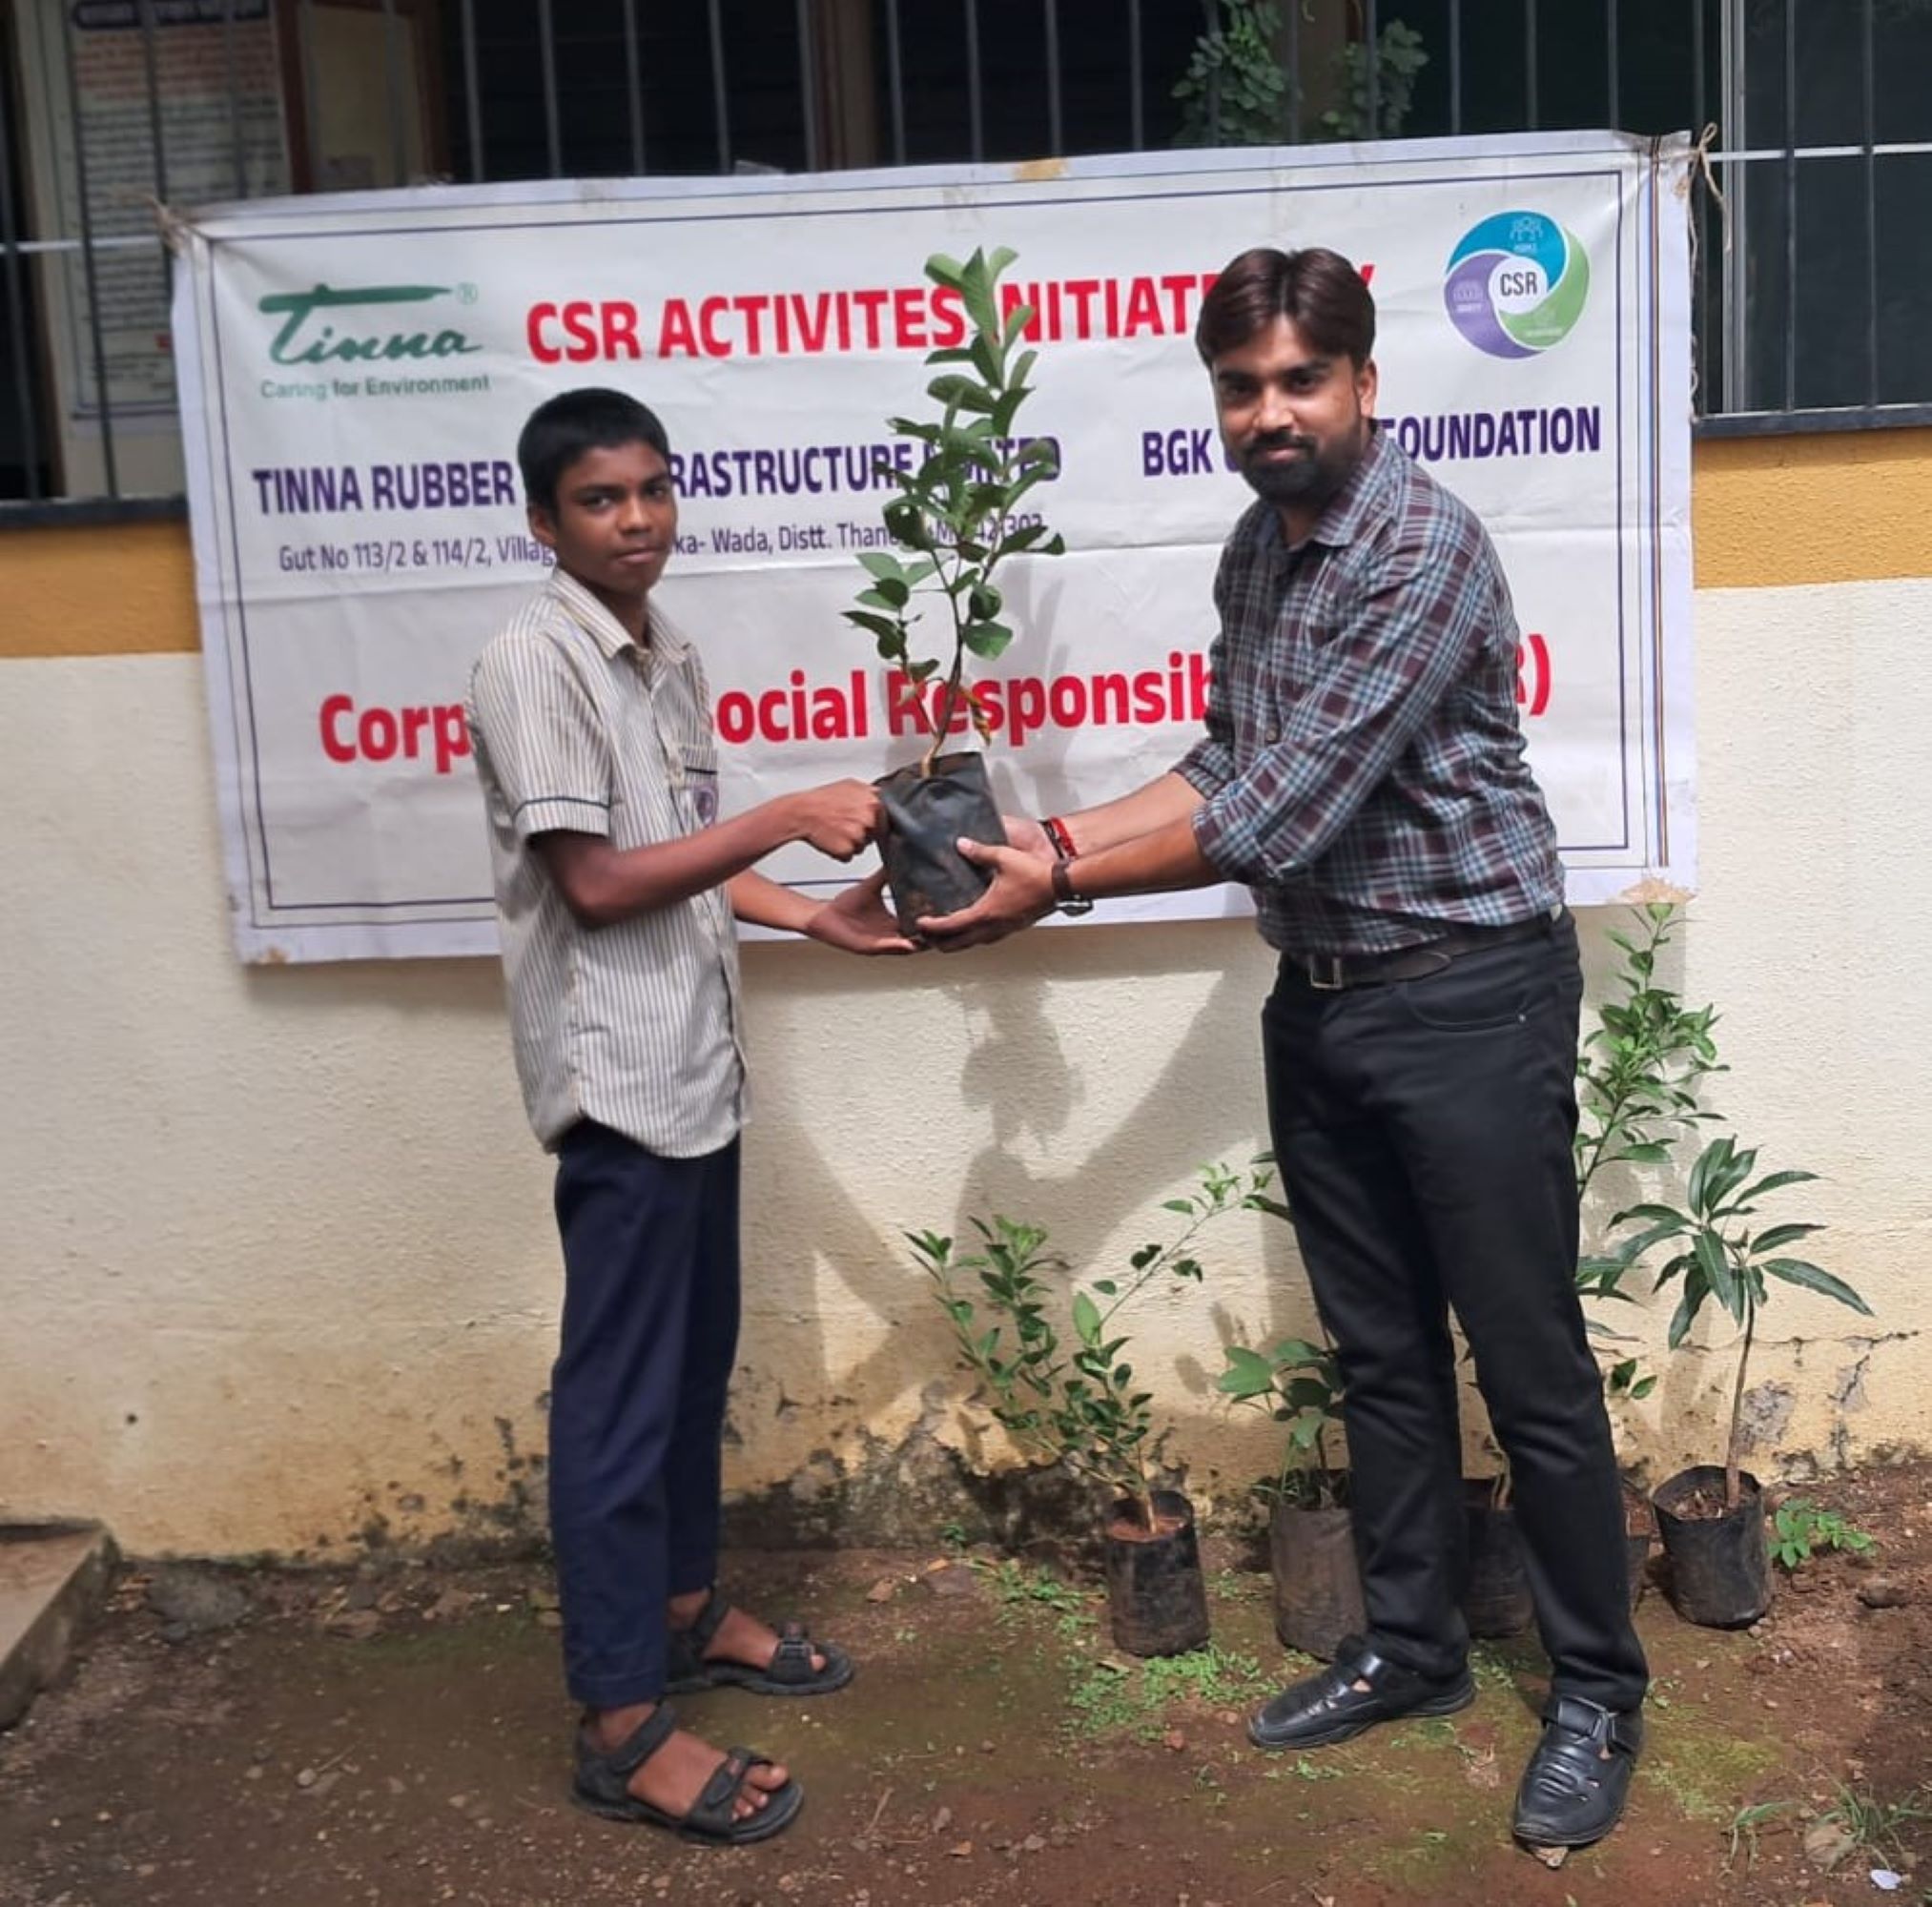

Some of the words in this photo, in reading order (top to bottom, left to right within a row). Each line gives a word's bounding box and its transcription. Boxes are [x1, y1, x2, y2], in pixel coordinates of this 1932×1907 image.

[526, 301, 641, 364] CSR
[658, 285, 967, 359] ACTIVITES
[992, 273, 1224, 344] NITIAT
[1499, 272, 1538, 297] CSR
[261, 380, 328, 400] Caring
[334, 380, 360, 397] for
[365, 375, 491, 397] Environment
[252, 466, 363, 515] TINNA
[371, 461, 516, 511] RUBBER
[1142, 428, 1213, 476] BGK
[279, 545, 316, 571] Gut
[321, 543, 349, 569] No
[353, 541, 407, 570] 113/2
[413, 539, 428, 566] &
[432, 536, 492, 567] 114/2,
[496, 535, 554, 567] Villag
[711, 525, 773, 555] Wada,
[779, 522, 832, 551] Distt.
[319, 693, 472, 774] Corp
[716, 668, 868, 745] ocial
[887, 651, 1217, 748] Responsib
